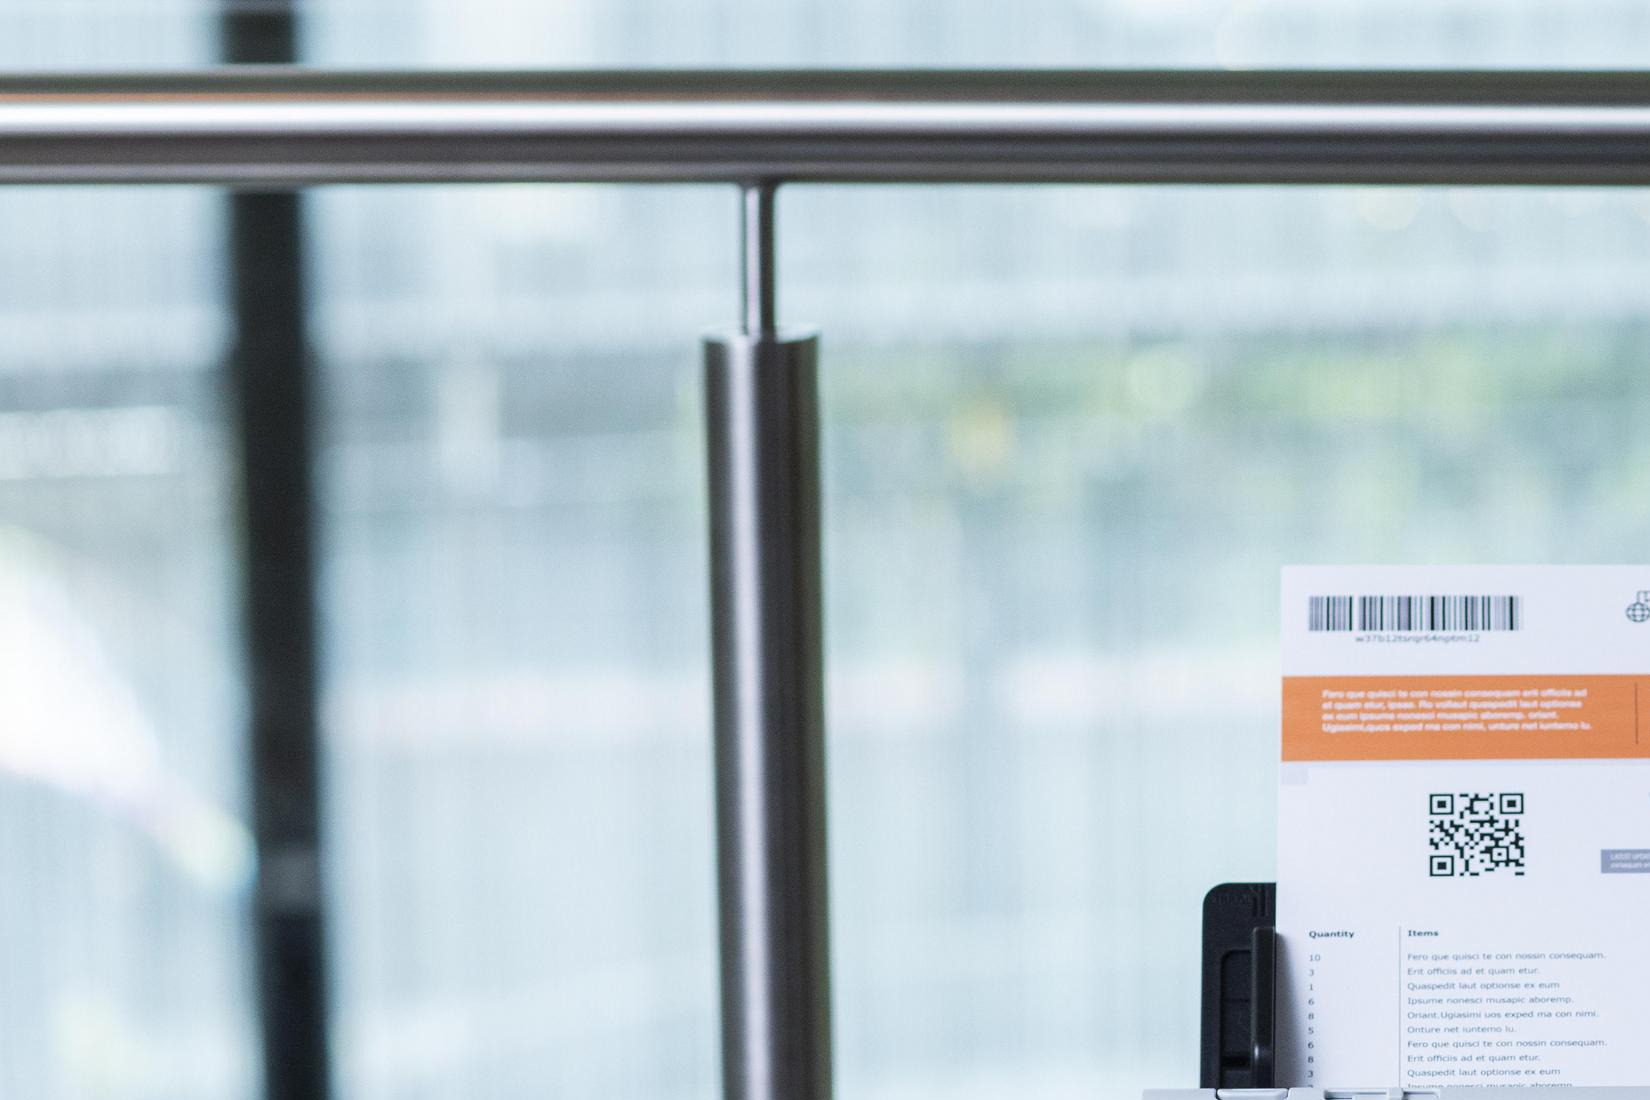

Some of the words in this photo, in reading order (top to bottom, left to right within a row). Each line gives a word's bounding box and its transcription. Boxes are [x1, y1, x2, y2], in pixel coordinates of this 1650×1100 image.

[1309, 931, 1354, 939] Quantity
[1308, 954, 1320, 962] 10
[1452, 954, 1480, 962] quisci
[1488, 968, 1516, 976] quam
[1408, 983, 1456, 992] Quaspedit
[1480, 982, 1521, 990] optionse
[1408, 997, 1444, 1006] Ipsume
[1505, 1011, 1534, 1020] exped
[1308, 1041, 1314, 1049] 6
[1432, 1041, 1450, 1049] que
[1453, 1041, 1480, 1049] quisci
[1407, 1070, 1455, 1079] Quaspedit
[1481, 1069, 1522, 1077] optionse
